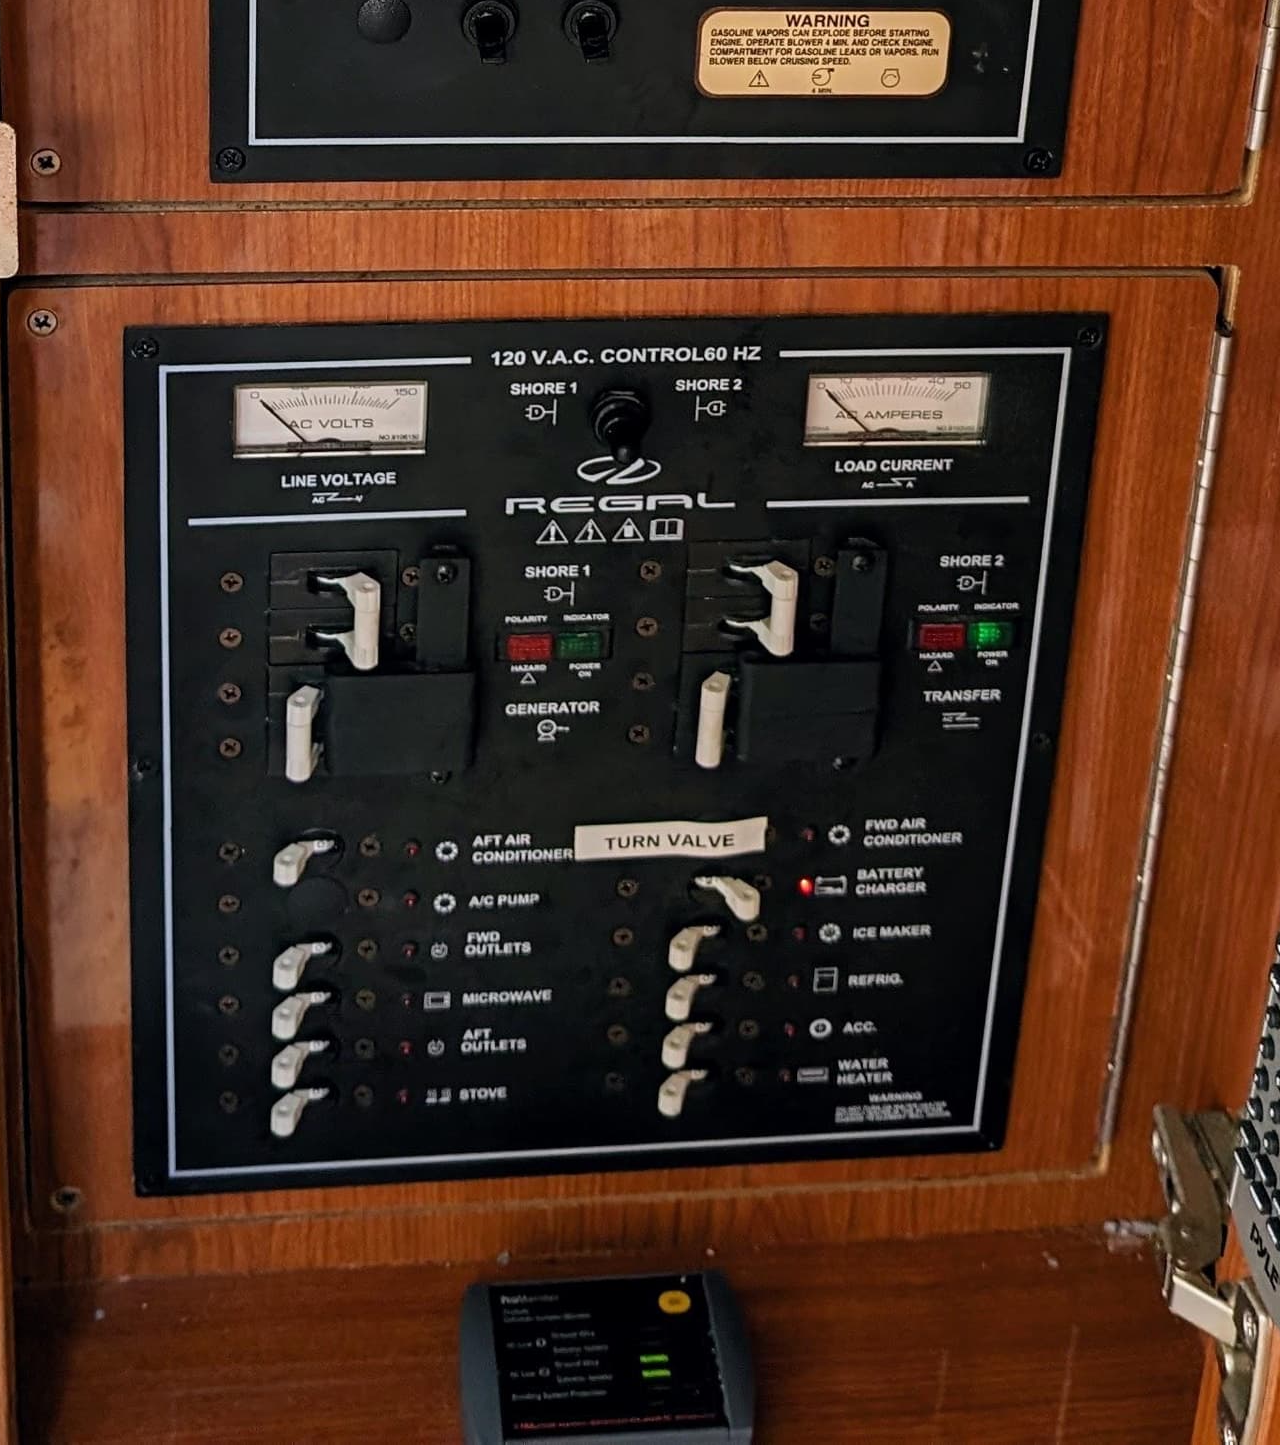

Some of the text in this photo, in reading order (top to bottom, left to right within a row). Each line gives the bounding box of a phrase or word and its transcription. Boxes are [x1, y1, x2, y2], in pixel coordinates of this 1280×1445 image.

[785, 14, 870, 28] WARNING
[711, 28, 930, 37] GASOLINE VAPORS CAN EXPLODE BEFORE STARTING
[746, 38, 934, 46] OPERATE BLOWER AND CHECK ENGINE
[709, 47, 939, 56] COMPARTMENT FOR GASOLINE LEAKS OR RUN
[709, 57, 820, 65] BLOWER BELOW CRUISING
[491, 351, 526, 366] 120
[531, 349, 595, 365] V.A.C.
[733, 346, 762, 361] HZ
[393, 387, 418, 397] 150
[510, 382, 578, 396] SHORE 1
[675, 378, 743, 392] SHORE 2
[953, 381, 971, 390] 50
[864, 409, 944, 421] AMPERES
[288, 418, 375, 430] AC VOLTS
[835, 458, 954, 473] LOAD CURRENT
[280, 472, 397, 489] LINE VOLTAGE
[505, 492, 736, 516] REGAL
[939, 553, 1004, 568] SHORE 2
[525, 566, 580, 579] SHORE
[918, 603, 960, 612] POLARITY
[504, 614, 548, 624] POLARITY
[923, 689, 1002, 703] TRANSFER
[505, 700, 601, 716] GENERATOR
[864, 817, 926, 832] FWD AIR
[472, 833, 531, 848] AFT AIR
[605, 833, 735, 850] TURN VALVE
[863, 831, 963, 847] CONDITIONER
[472, 847, 574, 863] CONDITIONER
[856, 866, 924, 881] BATTERY
[855, 881, 927, 896] CHARGER
[468, 892, 540, 908] A/C PUMP
[467, 930, 500, 943] FWD
[852, 923, 932, 940] ICE MAKER
[464, 941, 532, 955] OUTLETS
[848, 972, 904, 987] REFRIG.
[462, 988, 553, 1006] MICROWAVE
[842, 1020, 878, 1034] ACC.
[463, 1029, 492, 1041] AFT
[460, 1038, 527, 1053] OUTLETS
[837, 1057, 889, 1072] WATER
[836, 1070, 893, 1085] HEATER
[458, 1086, 507, 1102] STOVE
